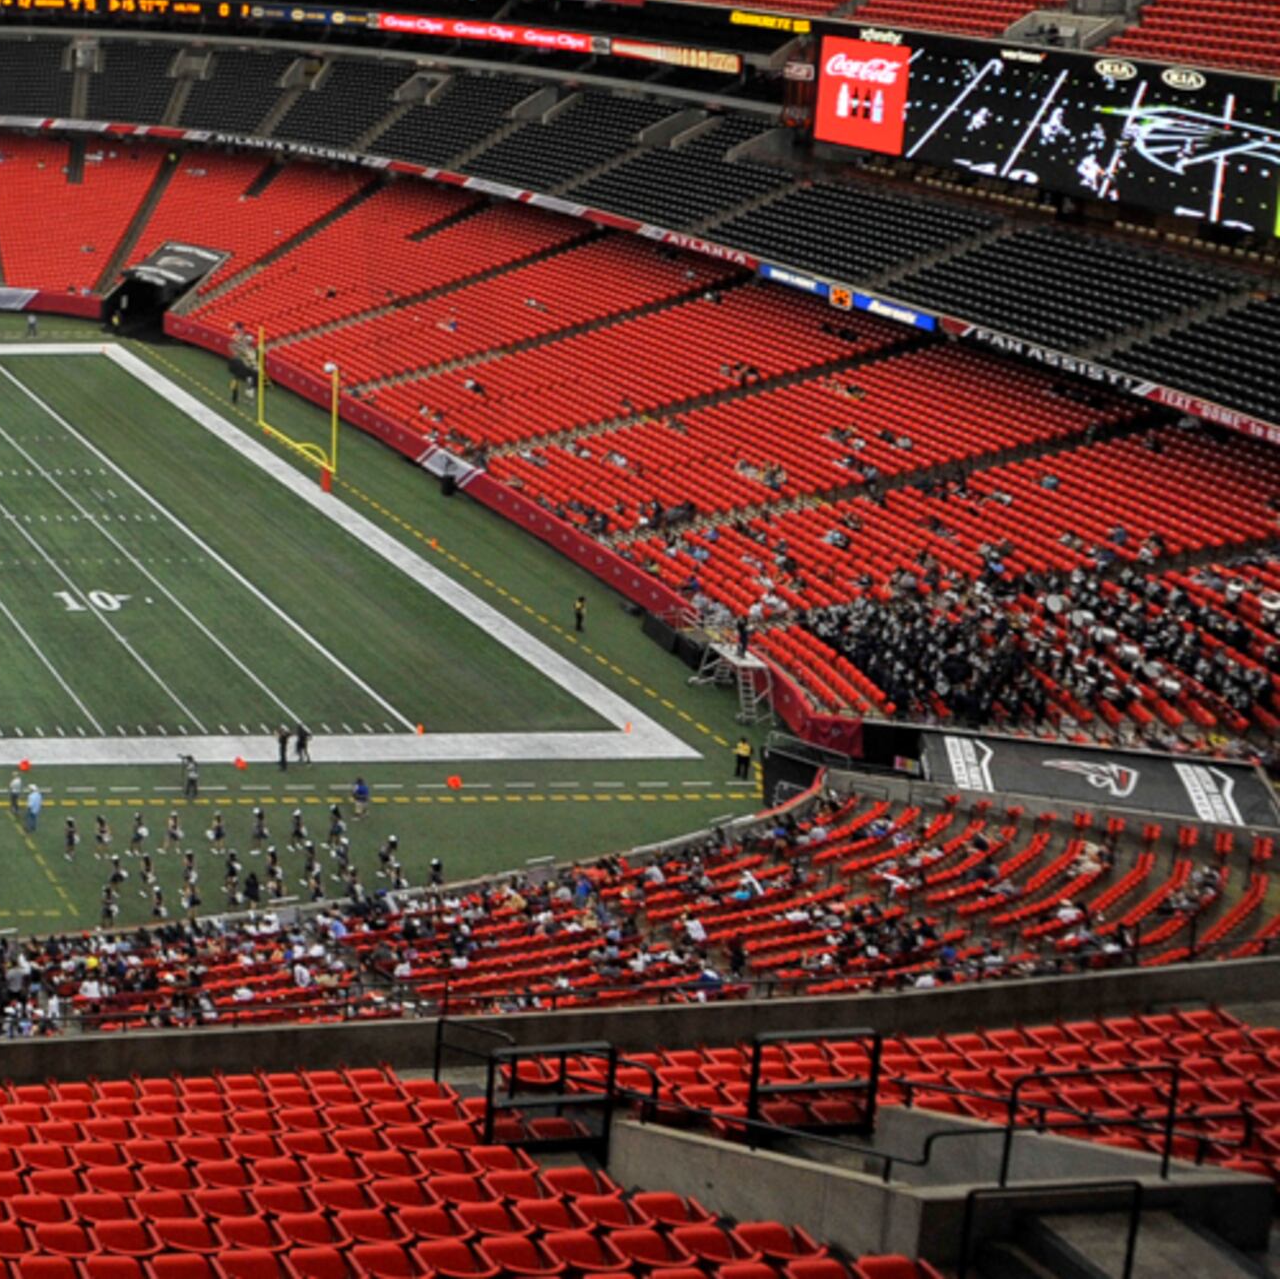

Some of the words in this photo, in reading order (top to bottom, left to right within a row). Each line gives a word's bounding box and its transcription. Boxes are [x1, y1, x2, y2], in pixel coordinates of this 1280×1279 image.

[669, 233, 746, 264] ATLANTA
[976, 328, 1021, 354] FAN
[54, 590, 122, 612] 10
